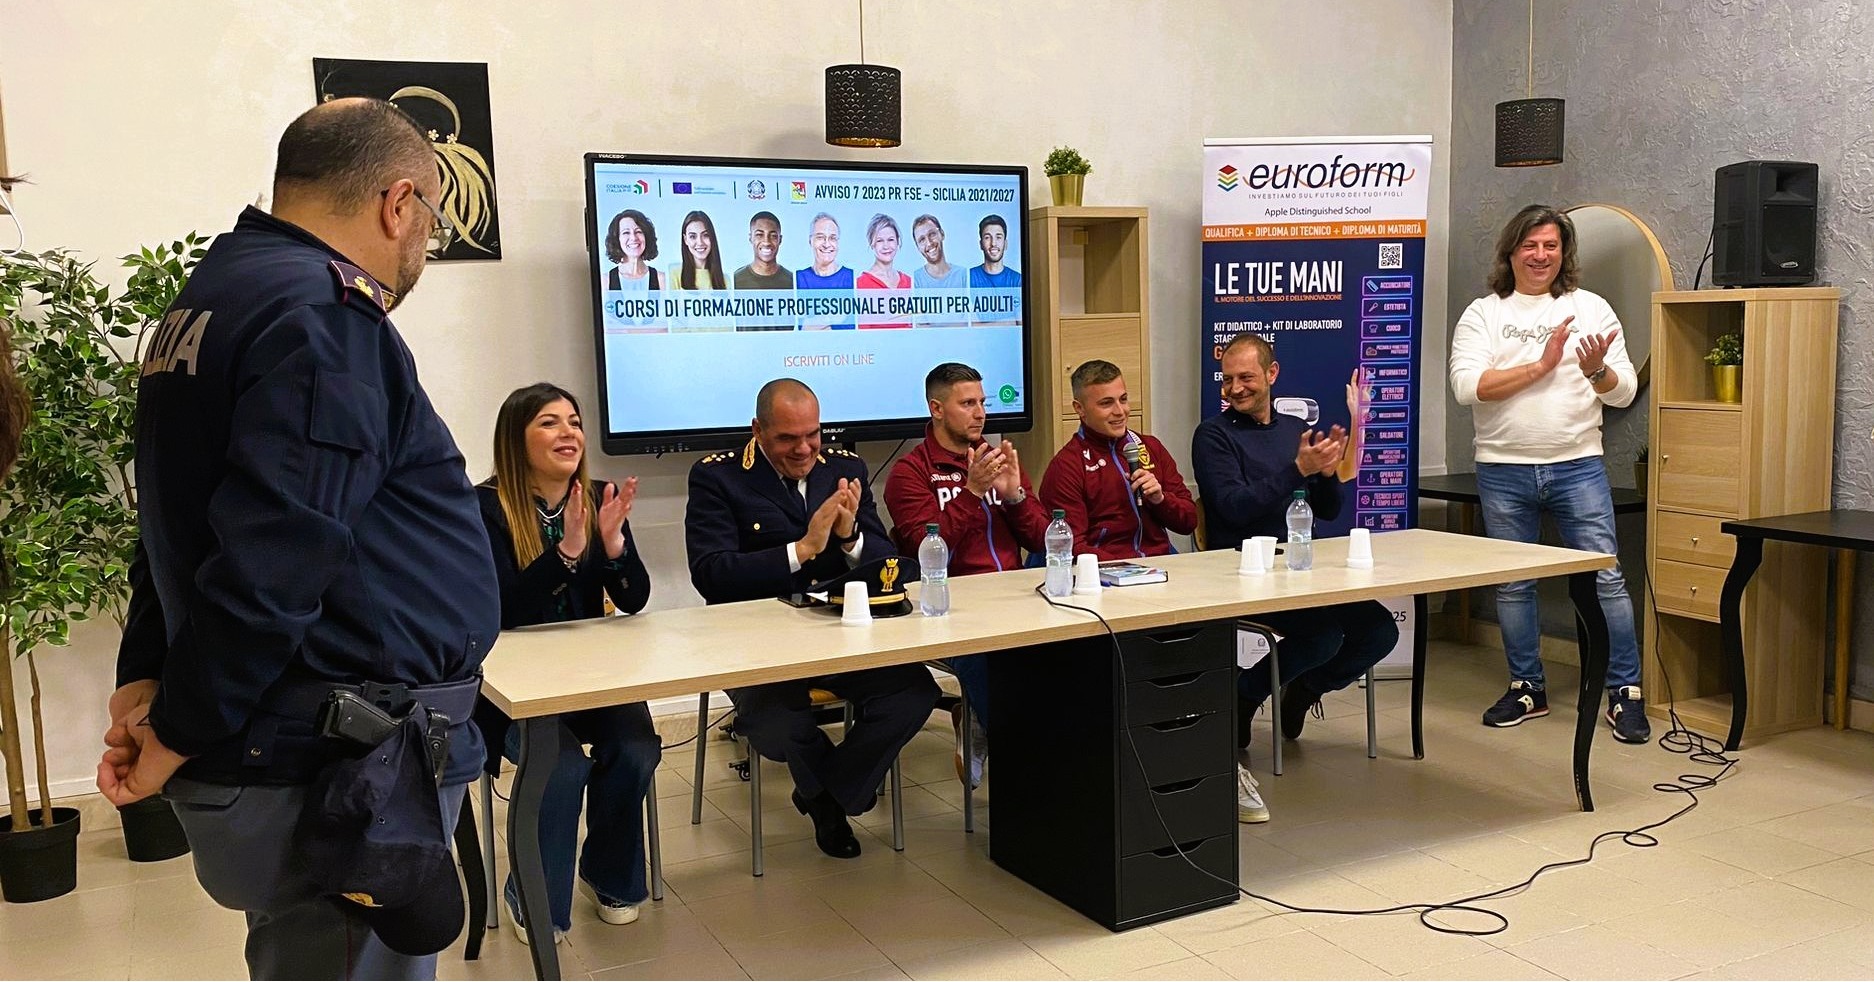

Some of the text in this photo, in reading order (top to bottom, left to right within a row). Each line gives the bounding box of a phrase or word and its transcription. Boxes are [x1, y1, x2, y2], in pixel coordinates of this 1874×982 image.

[1248, 154, 1407, 190] euroform
[815, 185, 851, 199] AVVISO
[853, 186, 859, 199] 7
[862, 186, 886, 200] 2023
[888, 187, 902, 200] PR
[904, 187, 922, 201] FSE
[933, 188, 966, 201] SICILIA
[968, 188, 1015, 202] 2021/2027
[1265, 206, 1371, 217] Apple Distinguished School
[1205, 227, 1245, 238] QUALIFICA
[1255, 226, 1289, 237] DIPLOMA
[1290, 226, 1299, 236] DI
[1300, 225, 1332, 236] TECNICO
[1342, 225, 1377, 235] DIPLOMA
[1378, 225, 1386, 234] DI
[1387, 222, 1422, 234] MATURITÀ
[1214, 260, 1343, 295] LE TUE MANI
[615, 295, 1013, 318] CORSI DI FORMAZIONE PROFESSIONALE GRATUITI PER ADULTI
[1214, 322, 1226, 331] KIT
[1227, 321, 1263, 331] DIDATTICO
[1272, 321, 1284, 331] KIT
[1285, 321, 1293, 330] DI
[1294, 319, 1343, 330] LABORATORIO
[783, 353, 875, 367] ISCRIVITI ON LINE
